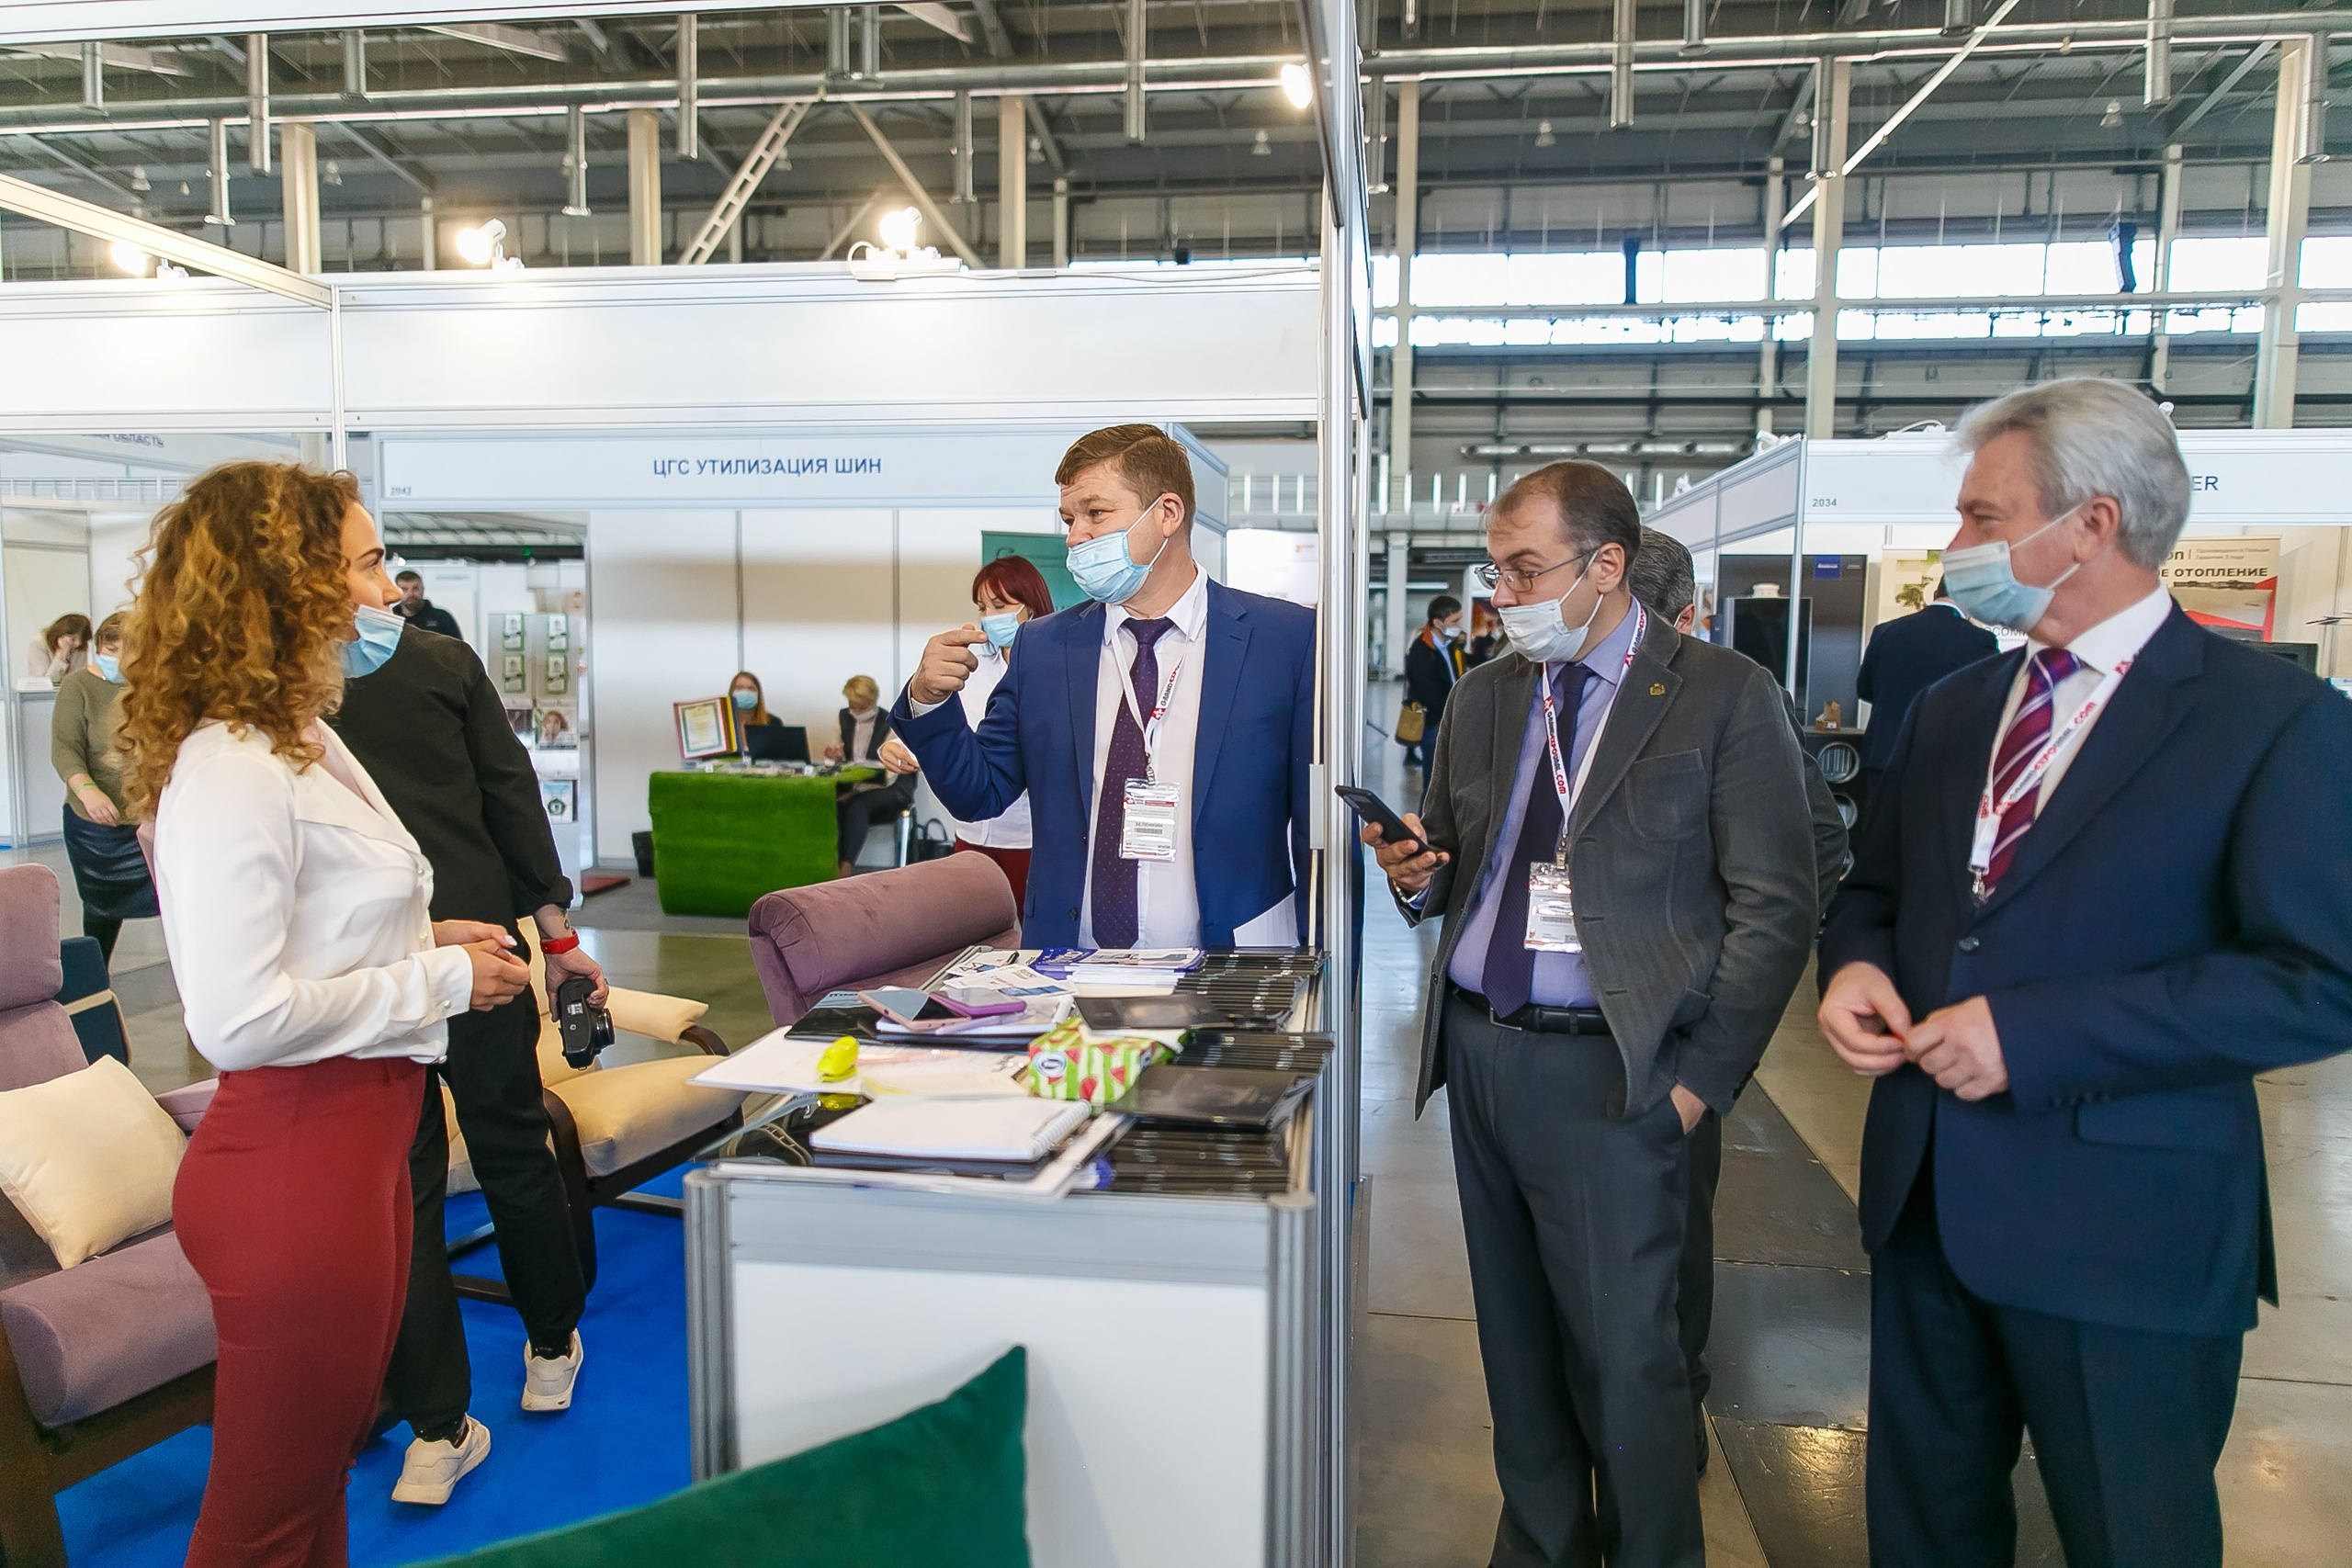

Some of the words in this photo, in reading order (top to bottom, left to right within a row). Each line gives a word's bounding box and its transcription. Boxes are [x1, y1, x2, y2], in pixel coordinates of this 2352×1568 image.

[653, 458, 691, 478] ЦГС
[696, 457, 828, 477] УТИЛИЗАЦИЯ
[834, 457, 882, 474] ШИН
[1812, 498, 1838, 508] 2034
[2174, 567, 2268, 578] ОТОПЛЕНИЕ
